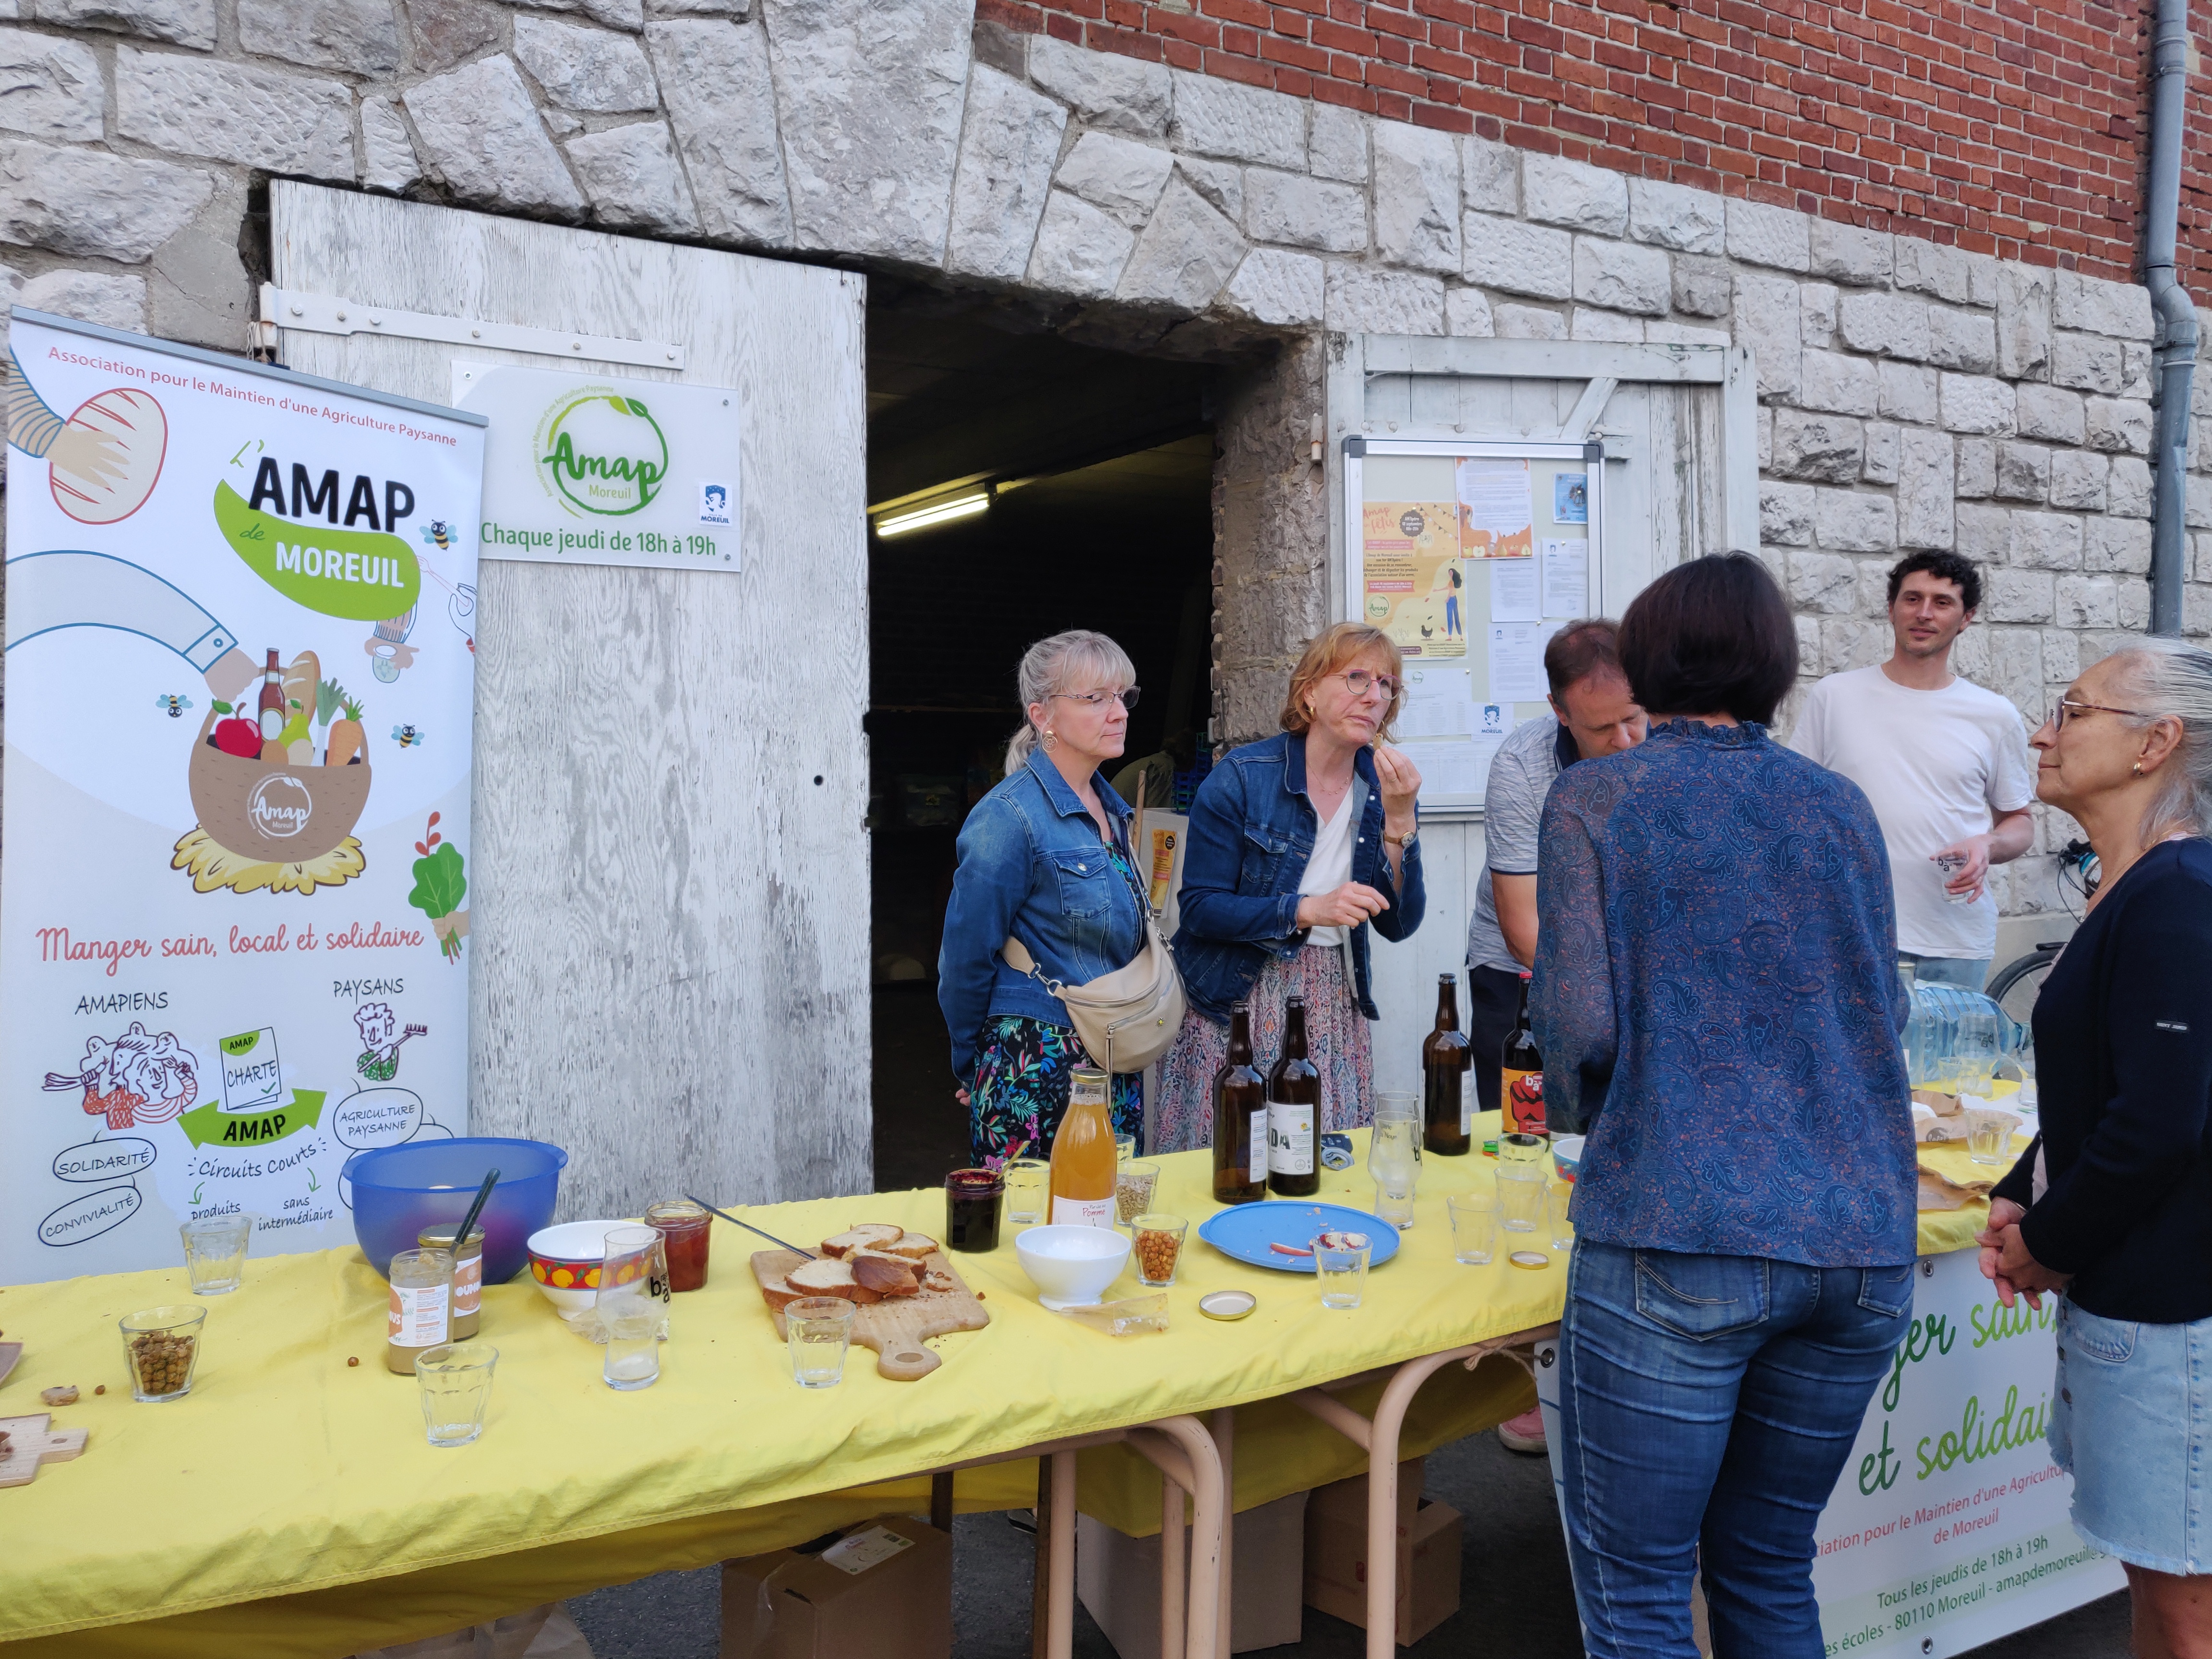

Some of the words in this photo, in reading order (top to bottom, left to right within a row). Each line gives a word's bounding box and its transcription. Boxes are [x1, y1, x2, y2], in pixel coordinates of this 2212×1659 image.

[48, 345, 148, 378] Association
[151, 372, 188, 387] pour
[193, 377, 205, 391] le
[211, 379, 277, 406] Maintien
[279, 397, 317, 416] d'une
[322, 405, 398, 432] Agriculture
[399, 421, 459, 446] Paysanne
[555, 388, 585, 406] Agriculture
[585, 385, 614, 393] Paysanne
[544, 403, 556, 417] d'une
[533, 417, 546, 442] Maintien
[533, 449, 542, 463] pour
[542, 432, 659, 503] Amap
[536, 465, 553, 497] Association
[589, 484, 631, 500] Moreuil
[240, 523, 266, 541] de
[480, 521, 553, 553] Chaque
[558, 528, 604, 554] jeudi
[610, 530, 632, 551] de
[637, 532, 668, 553] 18h
[673, 535, 682, 553] à
[686, 535, 715, 556] 19h
[276, 541, 404, 589] MOREUIL
[1369, 603, 1388, 614] Amap
[251, 796, 306, 830] Amap
[36, 927, 152, 976] Manger
[161, 934, 216, 957] sain,
[229, 924, 289, 953] local
[297, 923, 318, 950] et
[326, 921, 424, 949] solidaire
[75, 991, 168, 1015] AMAPIENS
[334, 978, 404, 1006] PAYSANS
[229, 1036, 254, 1050] AMAP
[227, 1061, 277, 1087] CHARTE
[339, 1104, 416, 1124] AGRICULTURE
[223, 1115, 287, 1142] AMAP
[348, 1119, 407, 1138] PAYSANNE
[57, 1149, 150, 1175] SOLIDARITÉ
[199, 1157, 262, 1179] Circuits
[45, 1195, 135, 1238] CONVIVIALITÉ
[191, 1201, 241, 1220] produits
[283, 1197, 312, 1211] sans
[1082, 1207, 1106, 1217] Pomme
[259, 1206, 333, 1231] intermédiaire
[1859, 1420, 1901, 1496] et
[1864, 1521, 1896, 1546] pour
[1900, 1515, 1911, 1530] le
[1914, 1498, 1971, 1525] Maintien
[1973, 1485, 2006, 1505] d'une
[1934, 1527, 1949, 1544] de
[1950, 1506, 1998, 1538] Moreuil
[1877, 1589, 1907, 1608] Tous
[1911, 1581, 1927, 1597] les
[1930, 1564, 1970, 1597] jeudis
[1972, 1557, 1987, 1575] de
[1992, 1547, 2012, 1567] 18h
[2016, 1544, 2022, 1559] à
[2026, 1535, 2047, 1554] 19h
[1842, 1625, 1884, 1650] écoles
[1893, 1600, 1934, 1630] 80110
[1936, 1584, 1985, 1614] Moreuil
